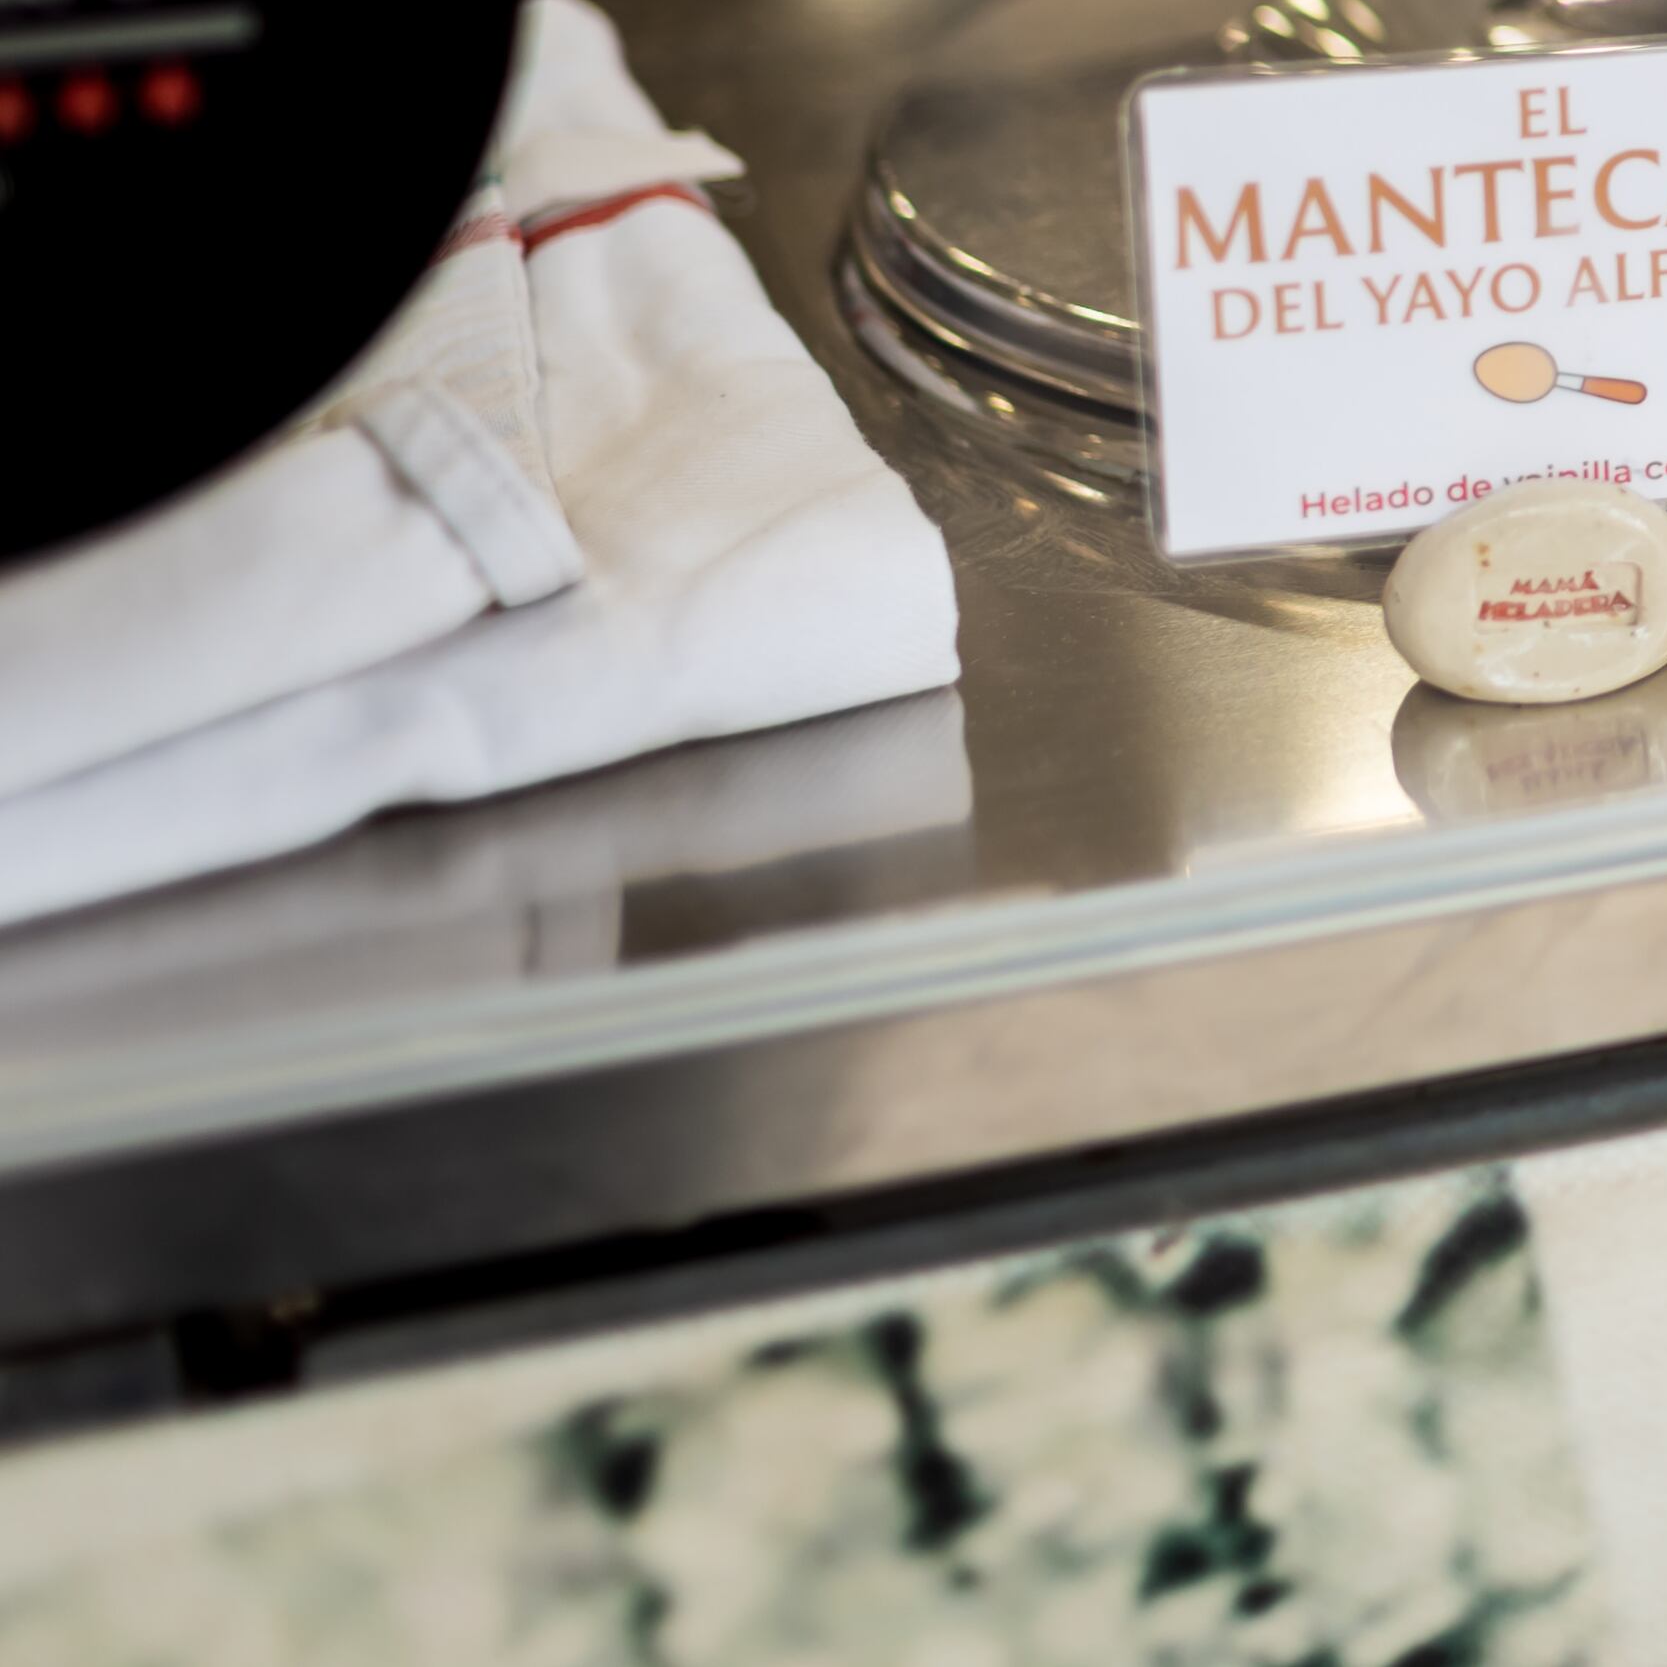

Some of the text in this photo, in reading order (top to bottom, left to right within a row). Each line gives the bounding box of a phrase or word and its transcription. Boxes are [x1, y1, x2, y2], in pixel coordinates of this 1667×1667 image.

[1517, 86, 1588, 140] EL
[1211, 280, 1344, 341] DEL
[1360, 262, 1542, 325] YAYO
[1301, 482, 1435, 518] Helado
[1448, 475, 1493, 504] de
[1503, 459, 1632, 485] iilla
[1478, 589, 1634, 623] HELADERA
[1509, 570, 1599, 595] MAMÁ
